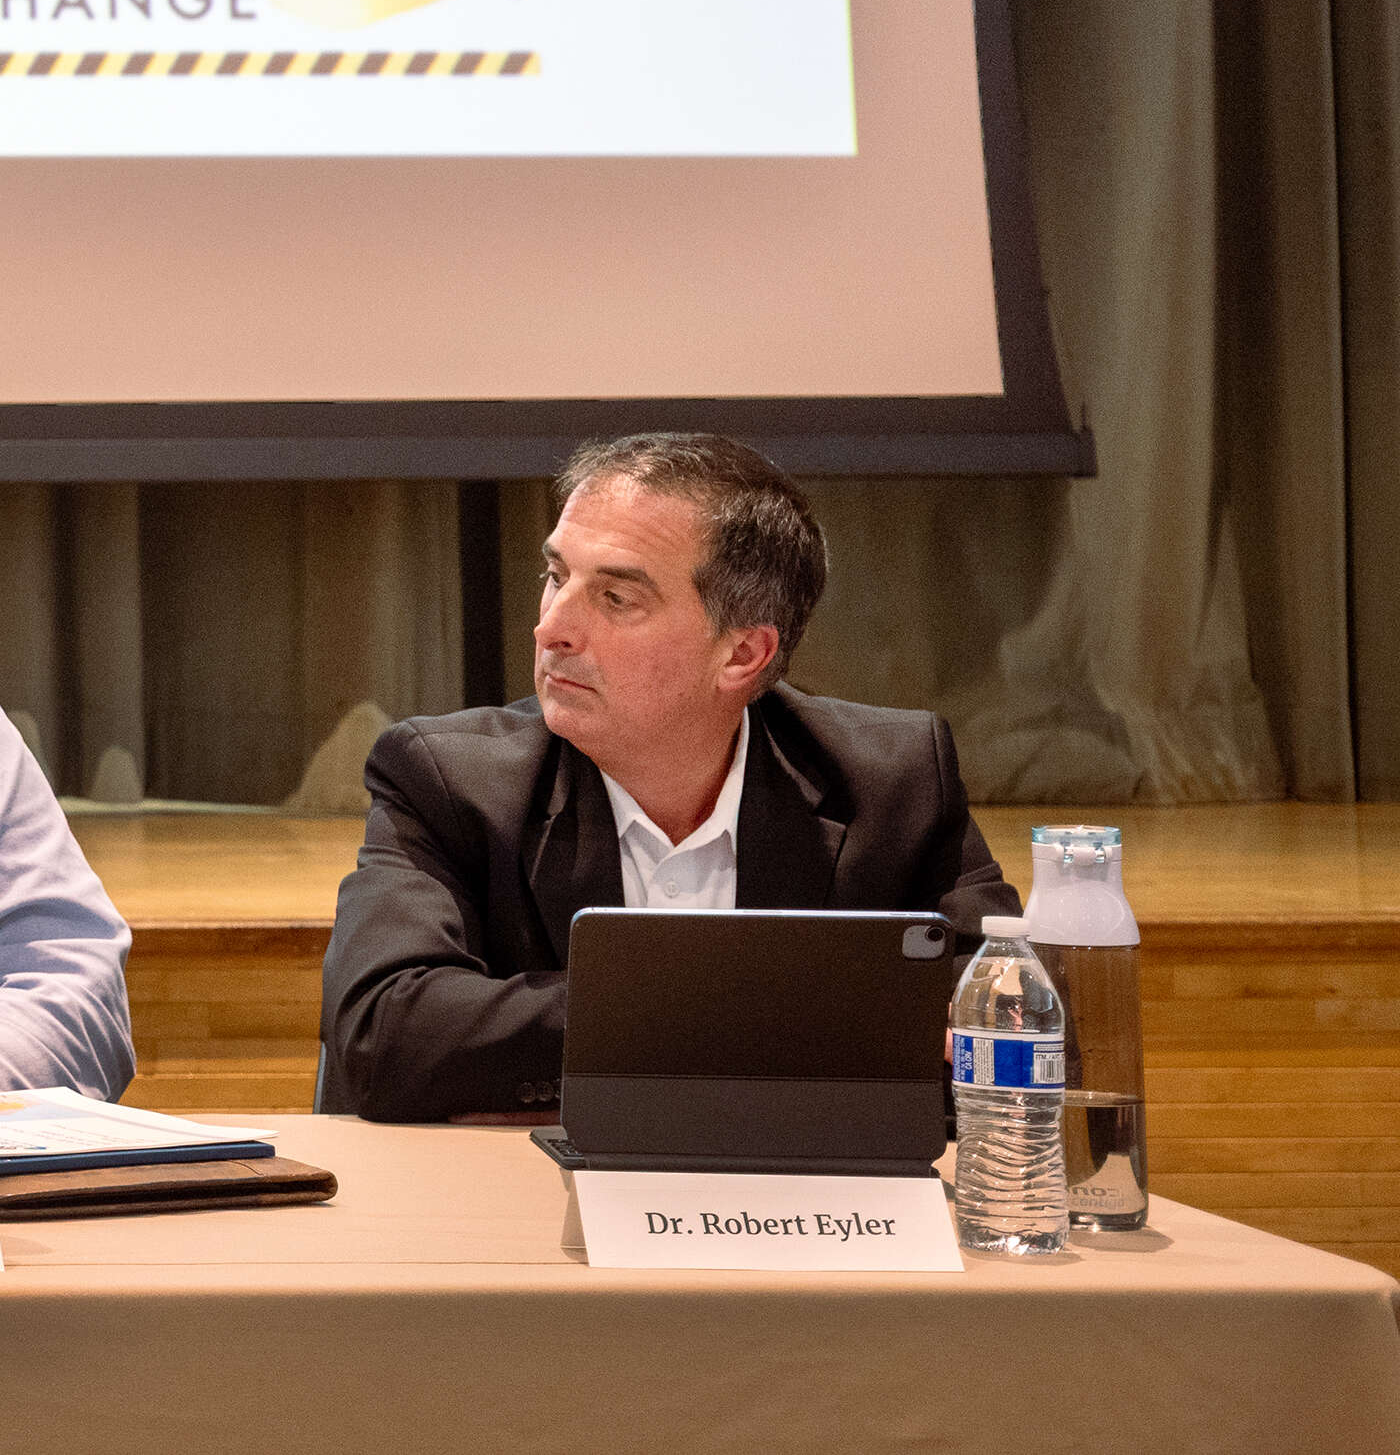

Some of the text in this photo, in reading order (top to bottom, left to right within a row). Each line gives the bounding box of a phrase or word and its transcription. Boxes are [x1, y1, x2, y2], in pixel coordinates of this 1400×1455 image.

[644, 1211, 897, 1242] Dr. Robert Eyler
